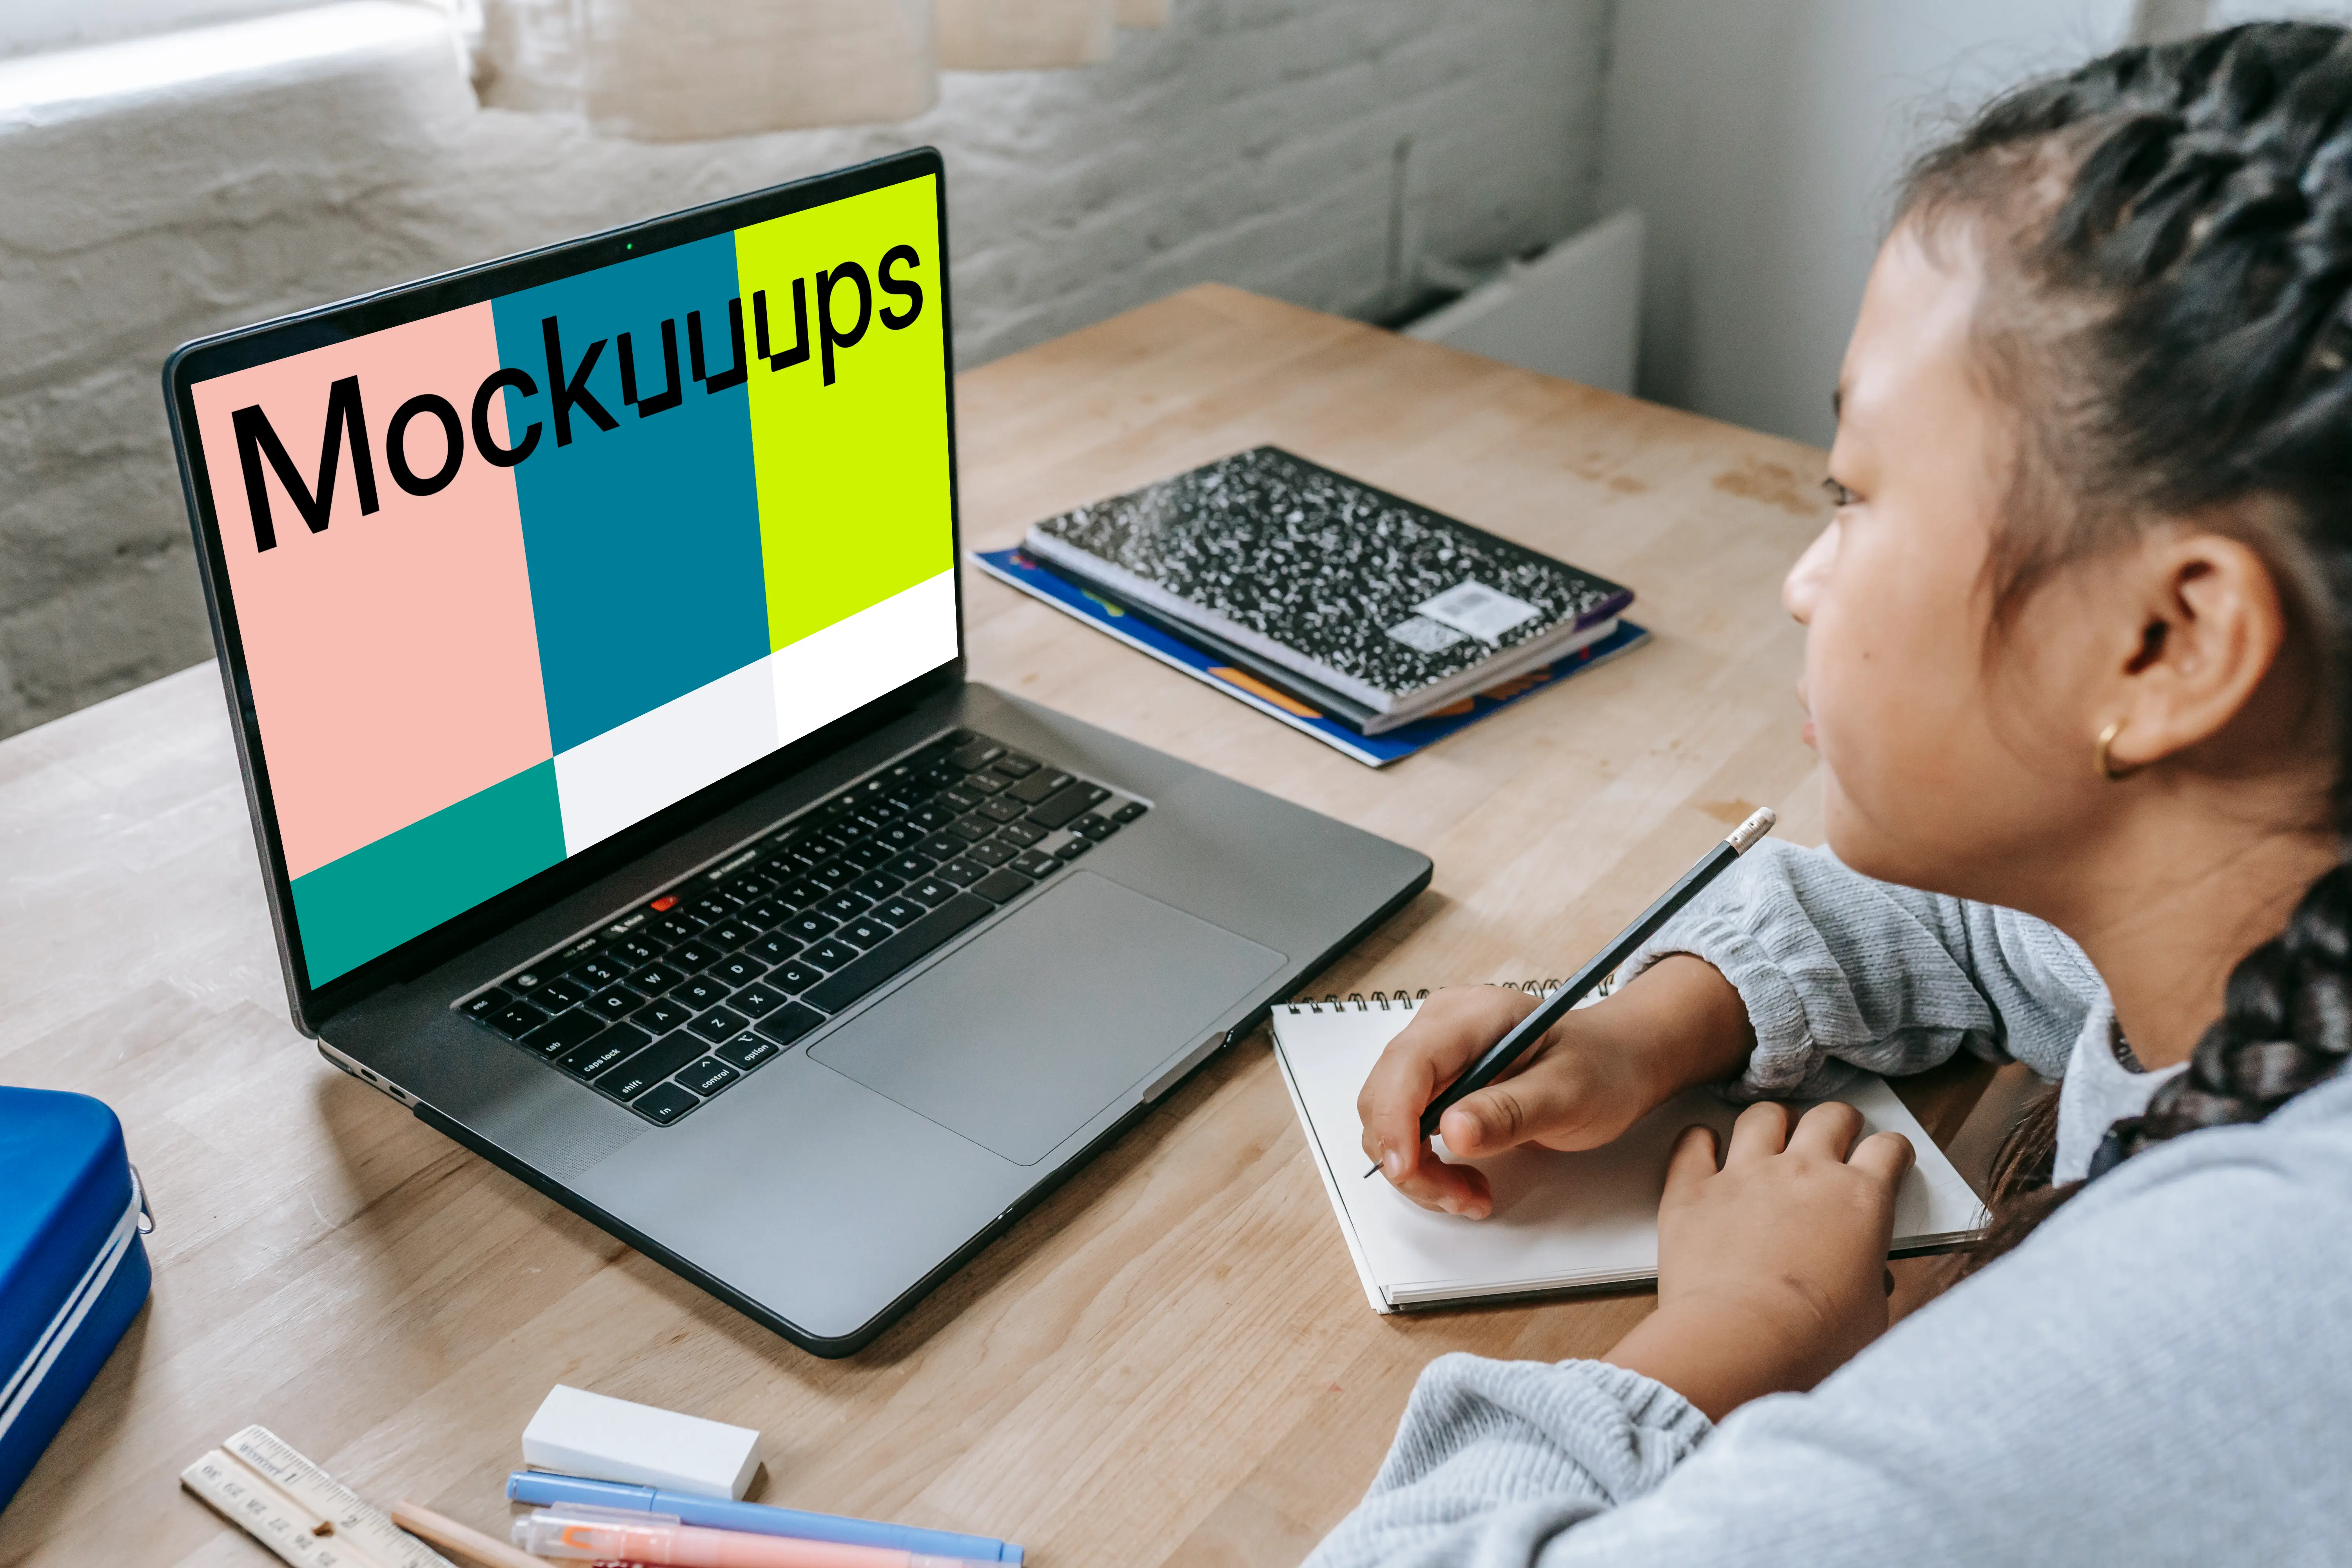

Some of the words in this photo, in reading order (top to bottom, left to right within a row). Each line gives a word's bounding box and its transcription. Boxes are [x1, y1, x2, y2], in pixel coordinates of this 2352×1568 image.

[232, 245, 923, 552] Mockuuups
[923, 886, 937, 895] M
[837, 900, 851, 909] H
[891, 907, 904, 915] N
[722, 931, 735, 939] R
[768, 943, 778, 951] F
[637, 948, 649, 956] 3
[686, 952, 699, 961] E
[731, 965, 743, 974] D
[645, 973, 661, 983] W
[787, 972, 800, 980] C
[693, 988, 706, 996] S
[608, 998, 622, 1006] Q
[749, 995, 763, 1004] X
[473, 1000, 488, 1010] esc
[656, 1012, 668, 1020] A
[711, 1018, 725, 1028] Z
[546, 1042, 561, 1052] tab
[744, 1044, 769, 1062] option
[584, 1059, 603, 1072] caps
[601, 1048, 621, 1060] lock
[702, 1069, 730, 1089] control
[622, 1080, 643, 1094] shift
[660, 1107, 671, 1115] fn
